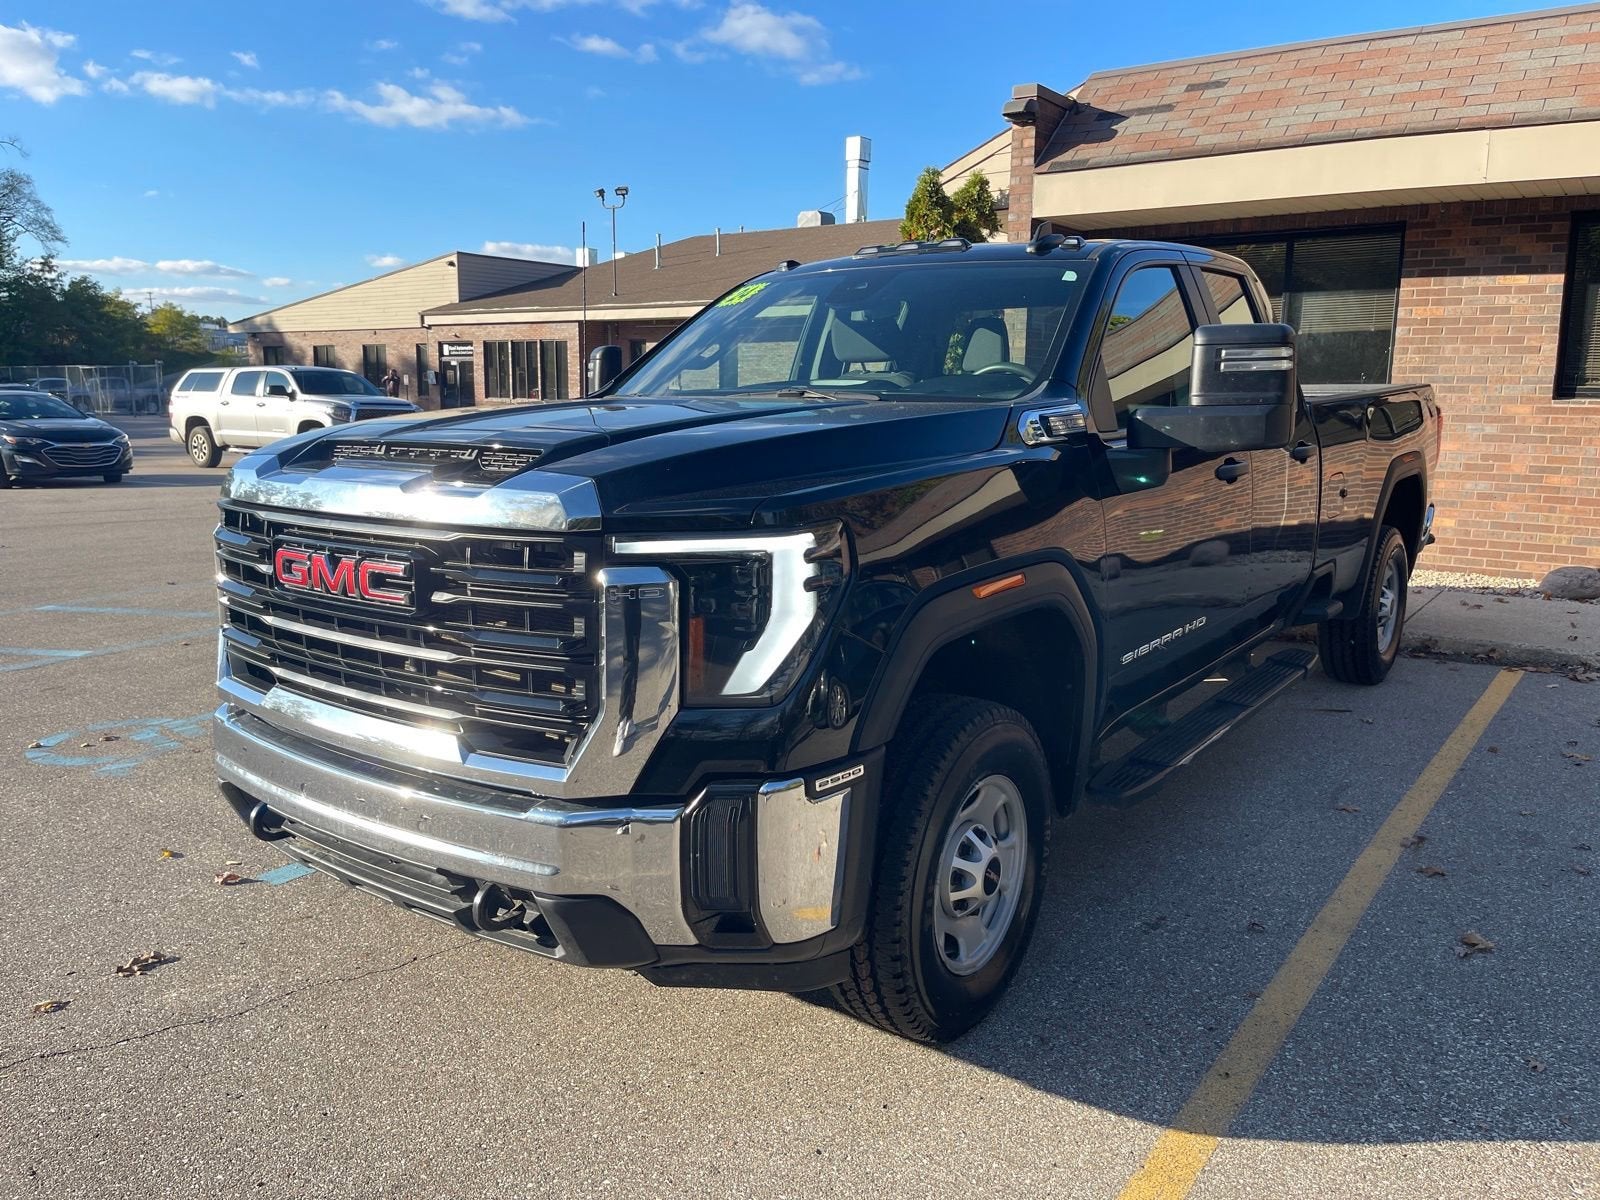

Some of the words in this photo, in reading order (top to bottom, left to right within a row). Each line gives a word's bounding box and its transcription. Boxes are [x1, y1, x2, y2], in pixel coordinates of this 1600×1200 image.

[275, 548, 409, 605] GMC
[1120, 627, 1183, 665] SIERRA
[1184, 616, 1207, 633] HD
[817, 766, 862, 789] 2500
